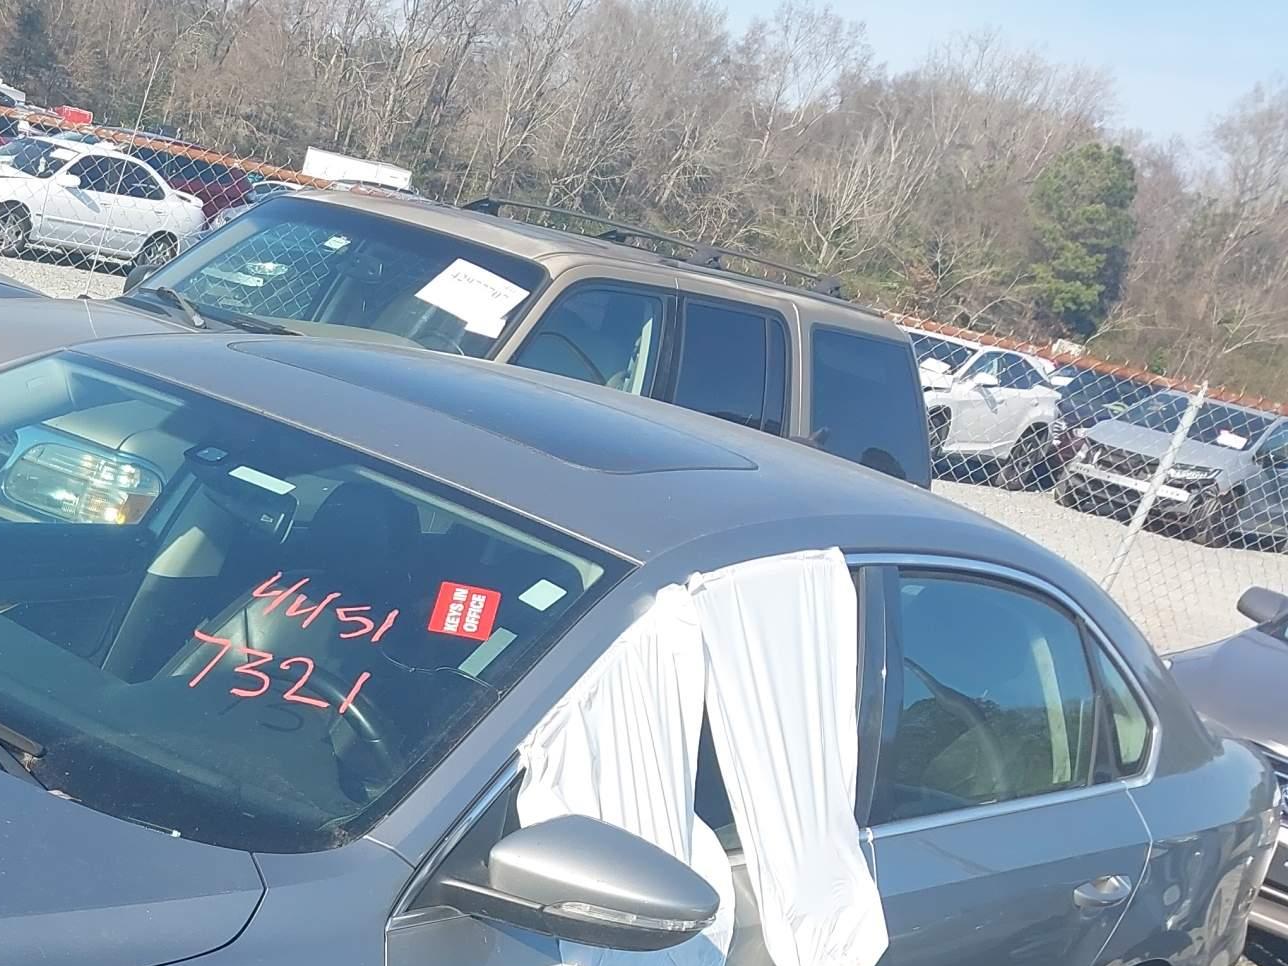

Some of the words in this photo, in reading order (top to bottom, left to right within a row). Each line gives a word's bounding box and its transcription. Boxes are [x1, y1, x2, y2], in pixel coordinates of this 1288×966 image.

[252, 571, 399, 642] 4451
[453, 587, 469, 602] IN
[463, 594, 486, 632] OFFICE
[444, 602, 464, 632] KEYS
[189, 629, 371, 714] 7321
